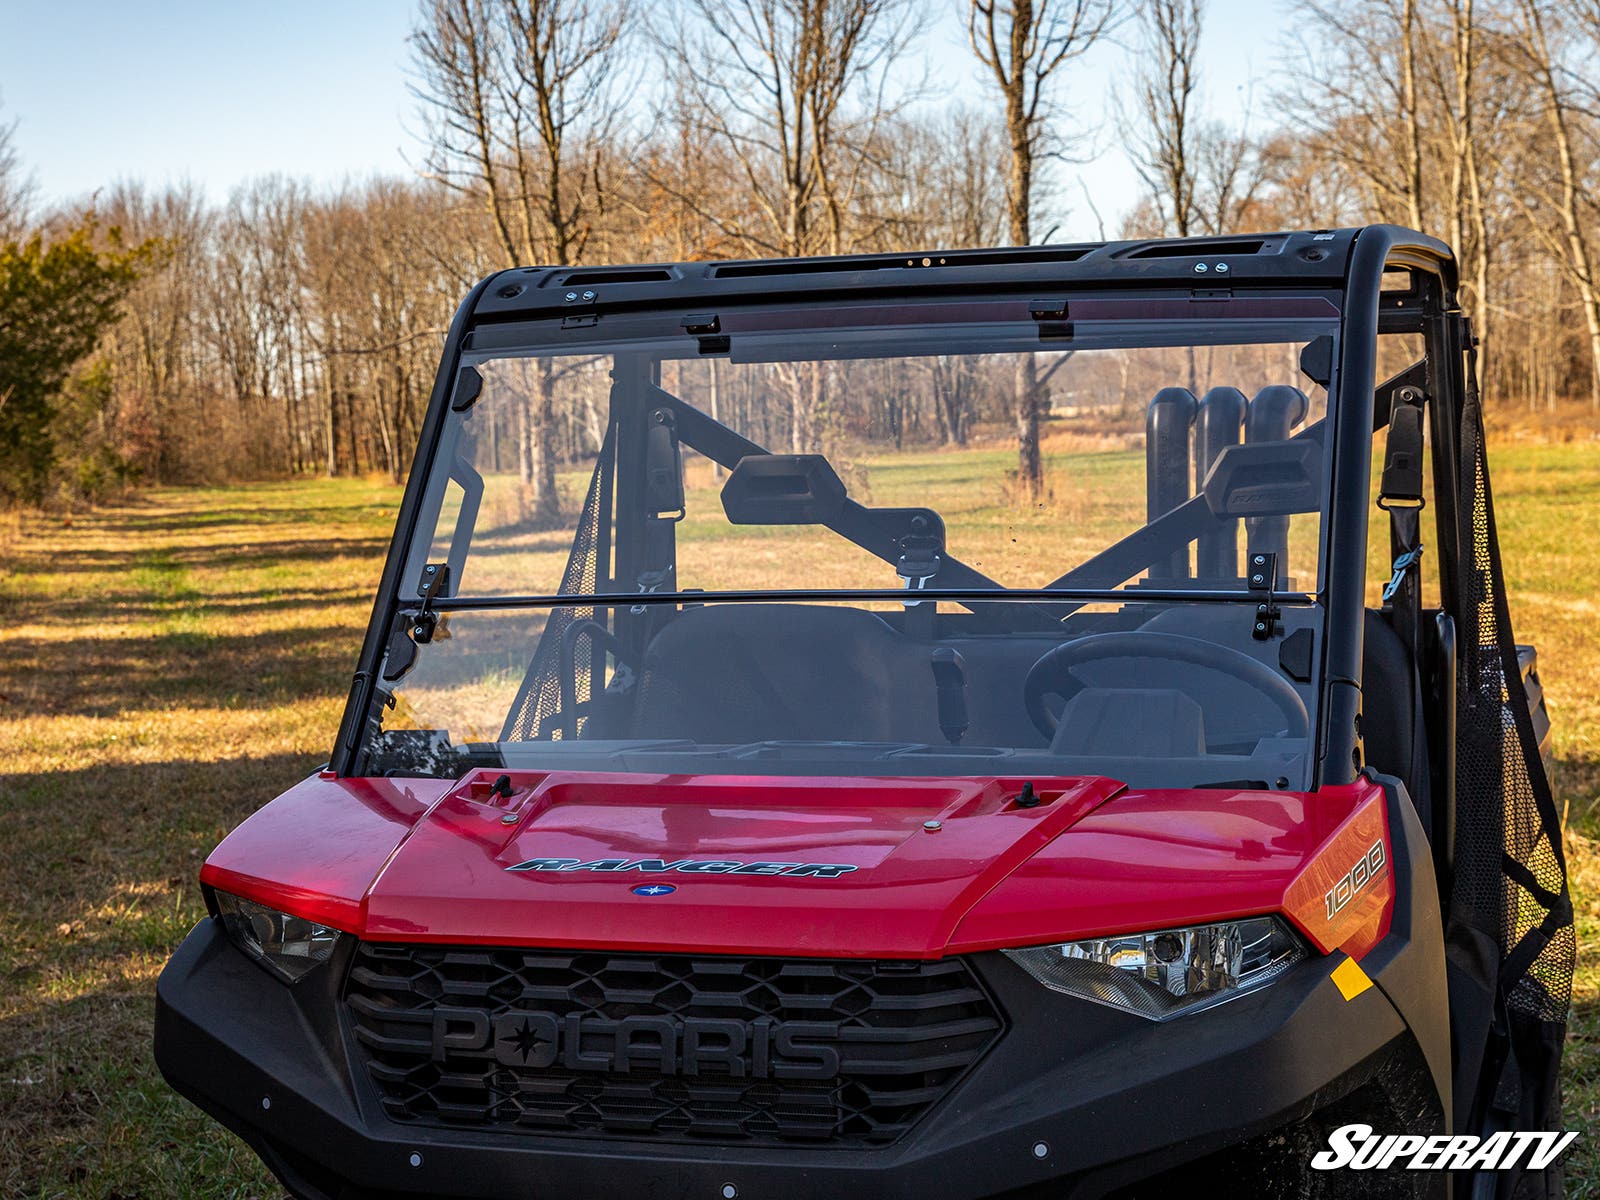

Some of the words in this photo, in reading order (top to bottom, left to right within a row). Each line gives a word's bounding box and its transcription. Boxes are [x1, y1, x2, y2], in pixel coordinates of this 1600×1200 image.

[504, 858, 859, 878] RANGER
[1324, 838, 1386, 921] 1000
[432, 1006, 840, 1078] POLARIS
